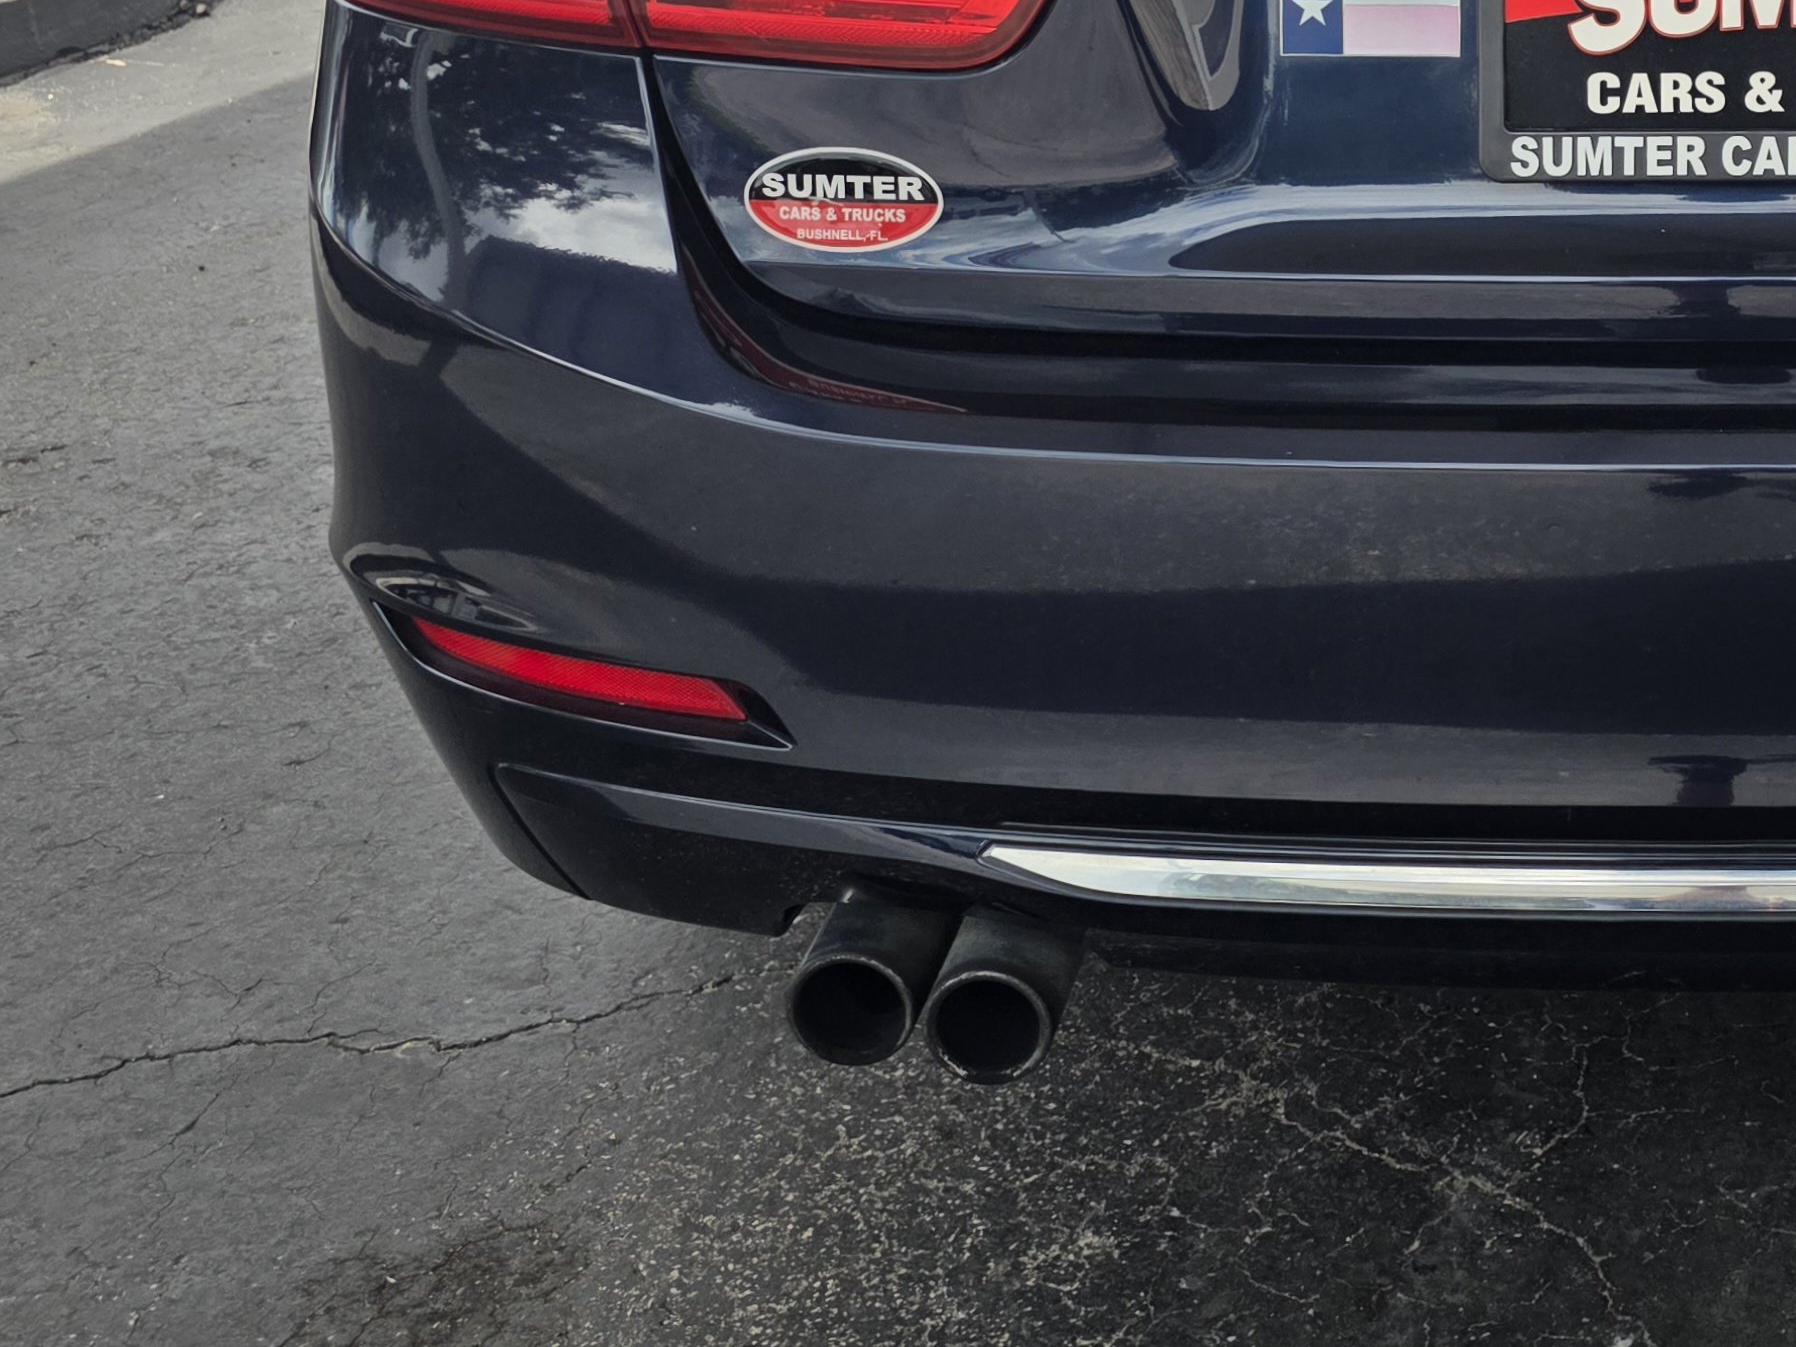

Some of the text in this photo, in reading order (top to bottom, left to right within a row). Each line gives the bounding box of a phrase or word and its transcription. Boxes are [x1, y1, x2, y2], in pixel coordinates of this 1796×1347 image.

[1585, 70, 1727, 115] CARS
[1744, 71, 1785, 113] &
[1510, 135, 1708, 179] SUMTER
[761, 172, 925, 201] SUMTER
[779, 206, 906, 222] CARS & TRUCKS
[796, 228, 867, 241] BUSHNELL,
